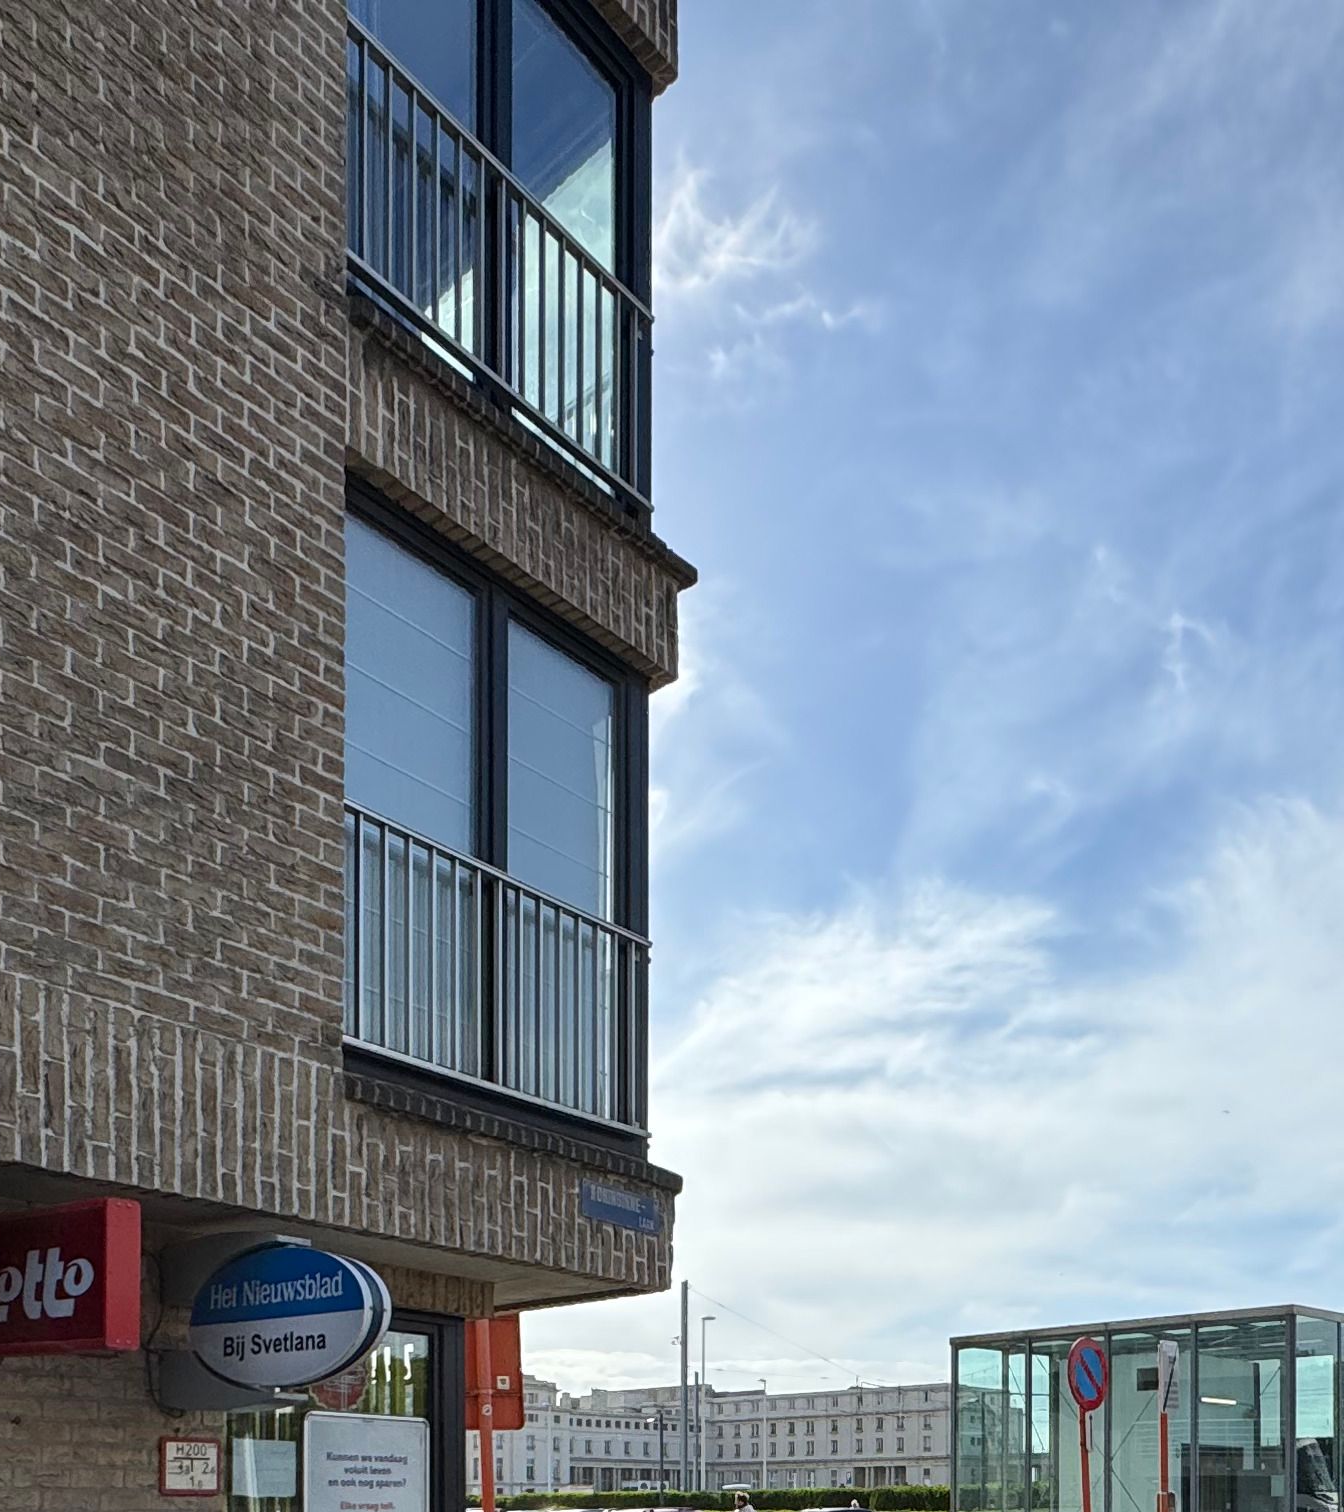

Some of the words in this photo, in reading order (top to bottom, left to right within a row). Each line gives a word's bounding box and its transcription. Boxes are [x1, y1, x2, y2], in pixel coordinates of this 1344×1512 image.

[209, 1284, 237, 1310] Het
[243, 1270, 344, 1306] Nieuwsblad
[223, 1336, 246, 1361] Bij
[250, 1331, 327, 1355] Svetlana
[176, 1443, 208, 1456] H200
[326, 1451, 359, 1461] Kunnen
[361, 1454, 373, 1462] we
[374, 1454, 408, 1465] vandaag
[358, 1479, 374, 1489] nog
[375, 1478, 407, 1489] sparen?
